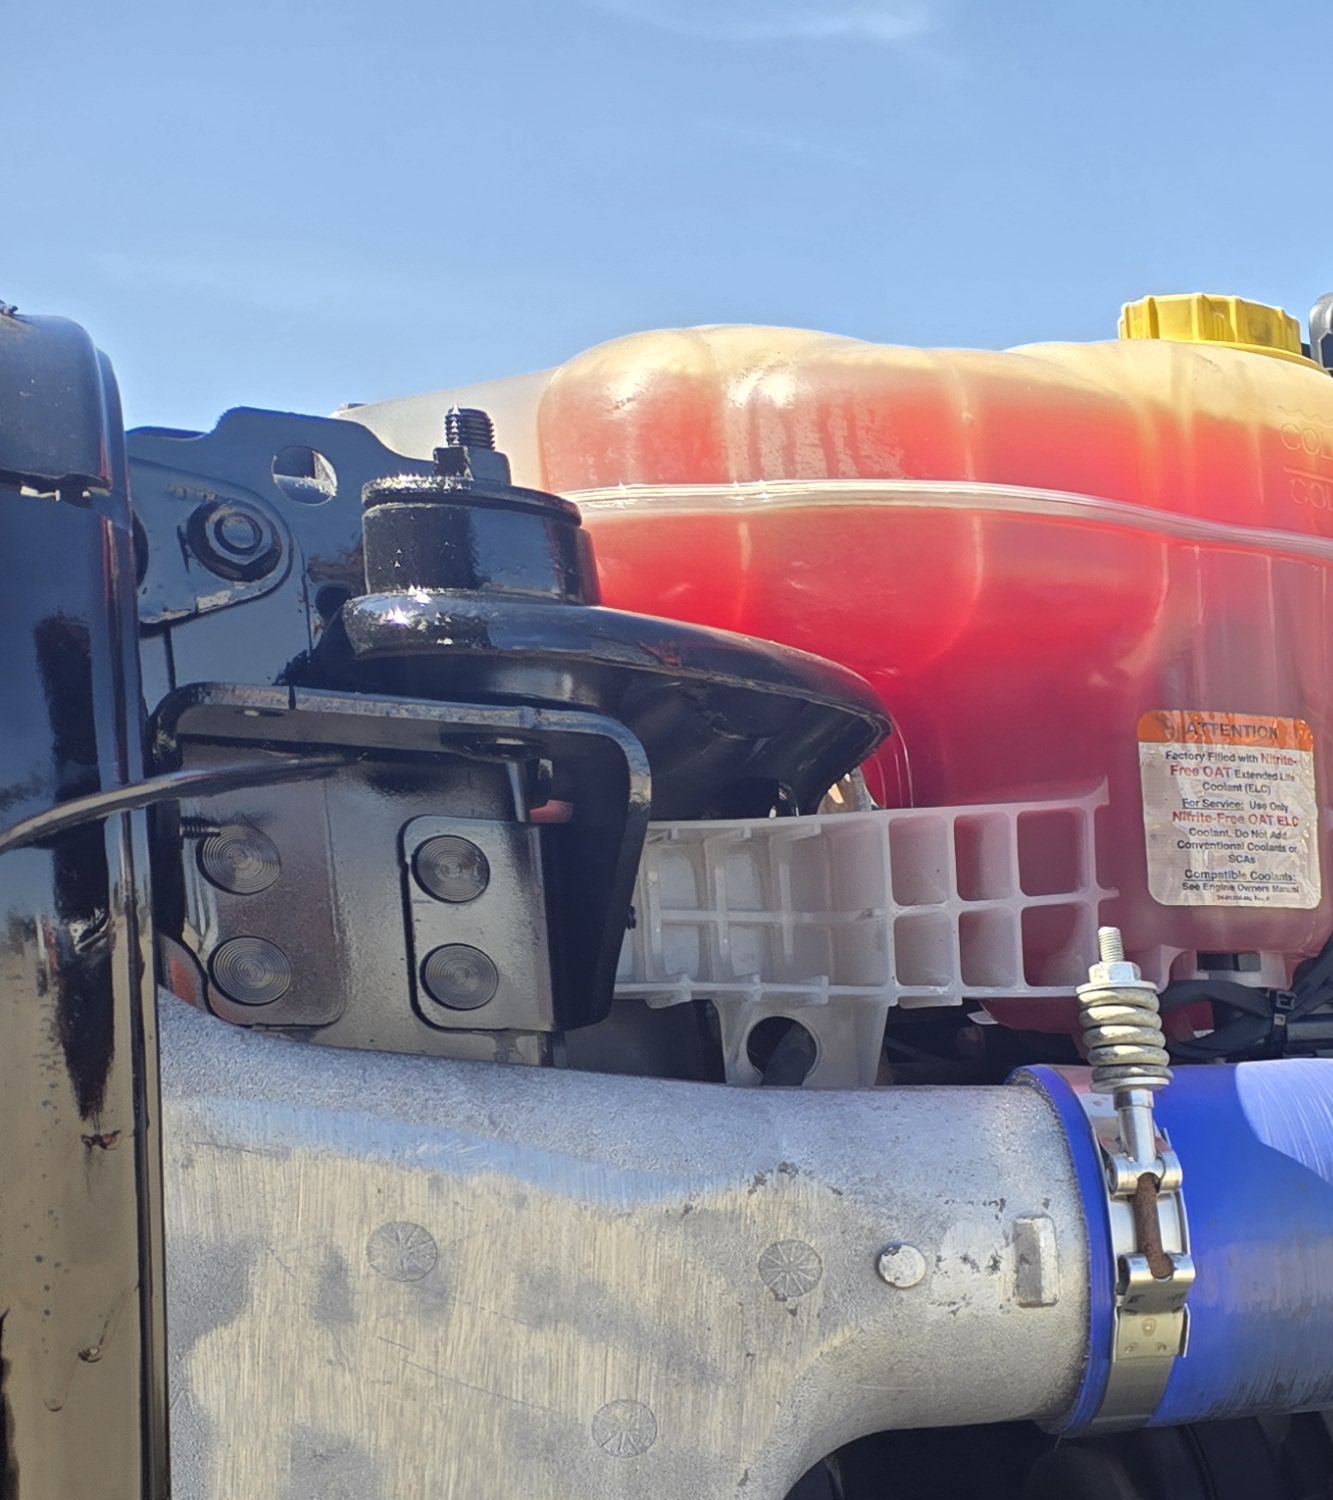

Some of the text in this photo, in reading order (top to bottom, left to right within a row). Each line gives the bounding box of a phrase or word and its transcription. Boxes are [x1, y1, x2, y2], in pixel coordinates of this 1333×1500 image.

[1186, 720, 1278, 740] ATTENTION
[1166, 751, 1298, 766] Factory Filled with Nitrite-
[1170, 765, 1296, 782] Free OAT Extended Life
[1202, 782, 1271, 796] Coolant (ELC)
[1182, 799, 1288, 814] For Service: Use Only
[1172, 811, 1299, 827] Nitrite-Free OAT ELC
[1235, 829, 1249, 839] Do
[1251, 829, 1268, 839] Not
[1270, 831, 1287, 841] Add
[1177, 840, 1297, 853] Conventional Coolants or
[1228, 854, 1256, 864] SCAs
[1184, 869, 1296, 882] Compatible Coolants:
[1182, 883, 1299, 894] See Engine Owners Manual
